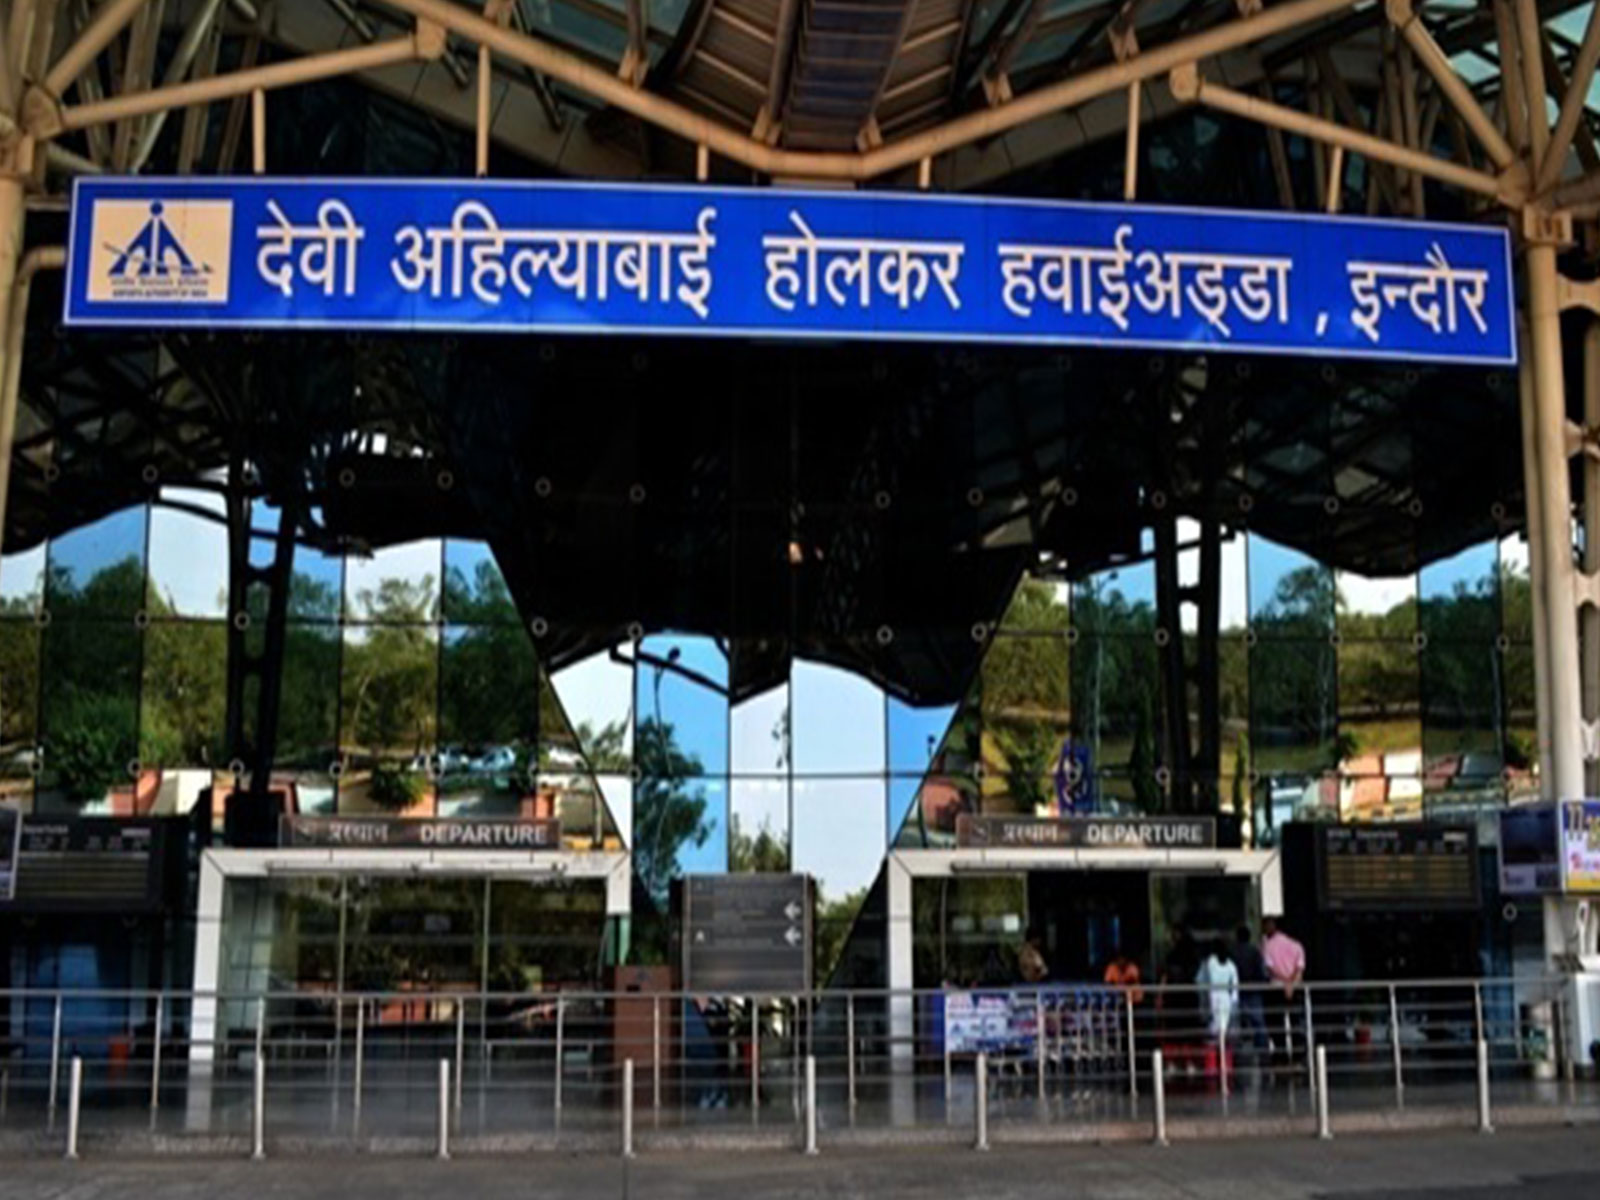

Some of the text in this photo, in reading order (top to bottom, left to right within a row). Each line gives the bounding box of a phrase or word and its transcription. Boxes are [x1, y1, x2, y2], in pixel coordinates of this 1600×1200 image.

[257, 200, 364, 296] देवी
[391, 201, 716, 318] अहिल्याबाई
[763, 211, 965, 310] होलकर
[1347, 242, 1488, 341] इन्दौर
[420, 823, 549, 845] DEPARTURE
[1086, 823, 1204, 845] DEPARTURE
